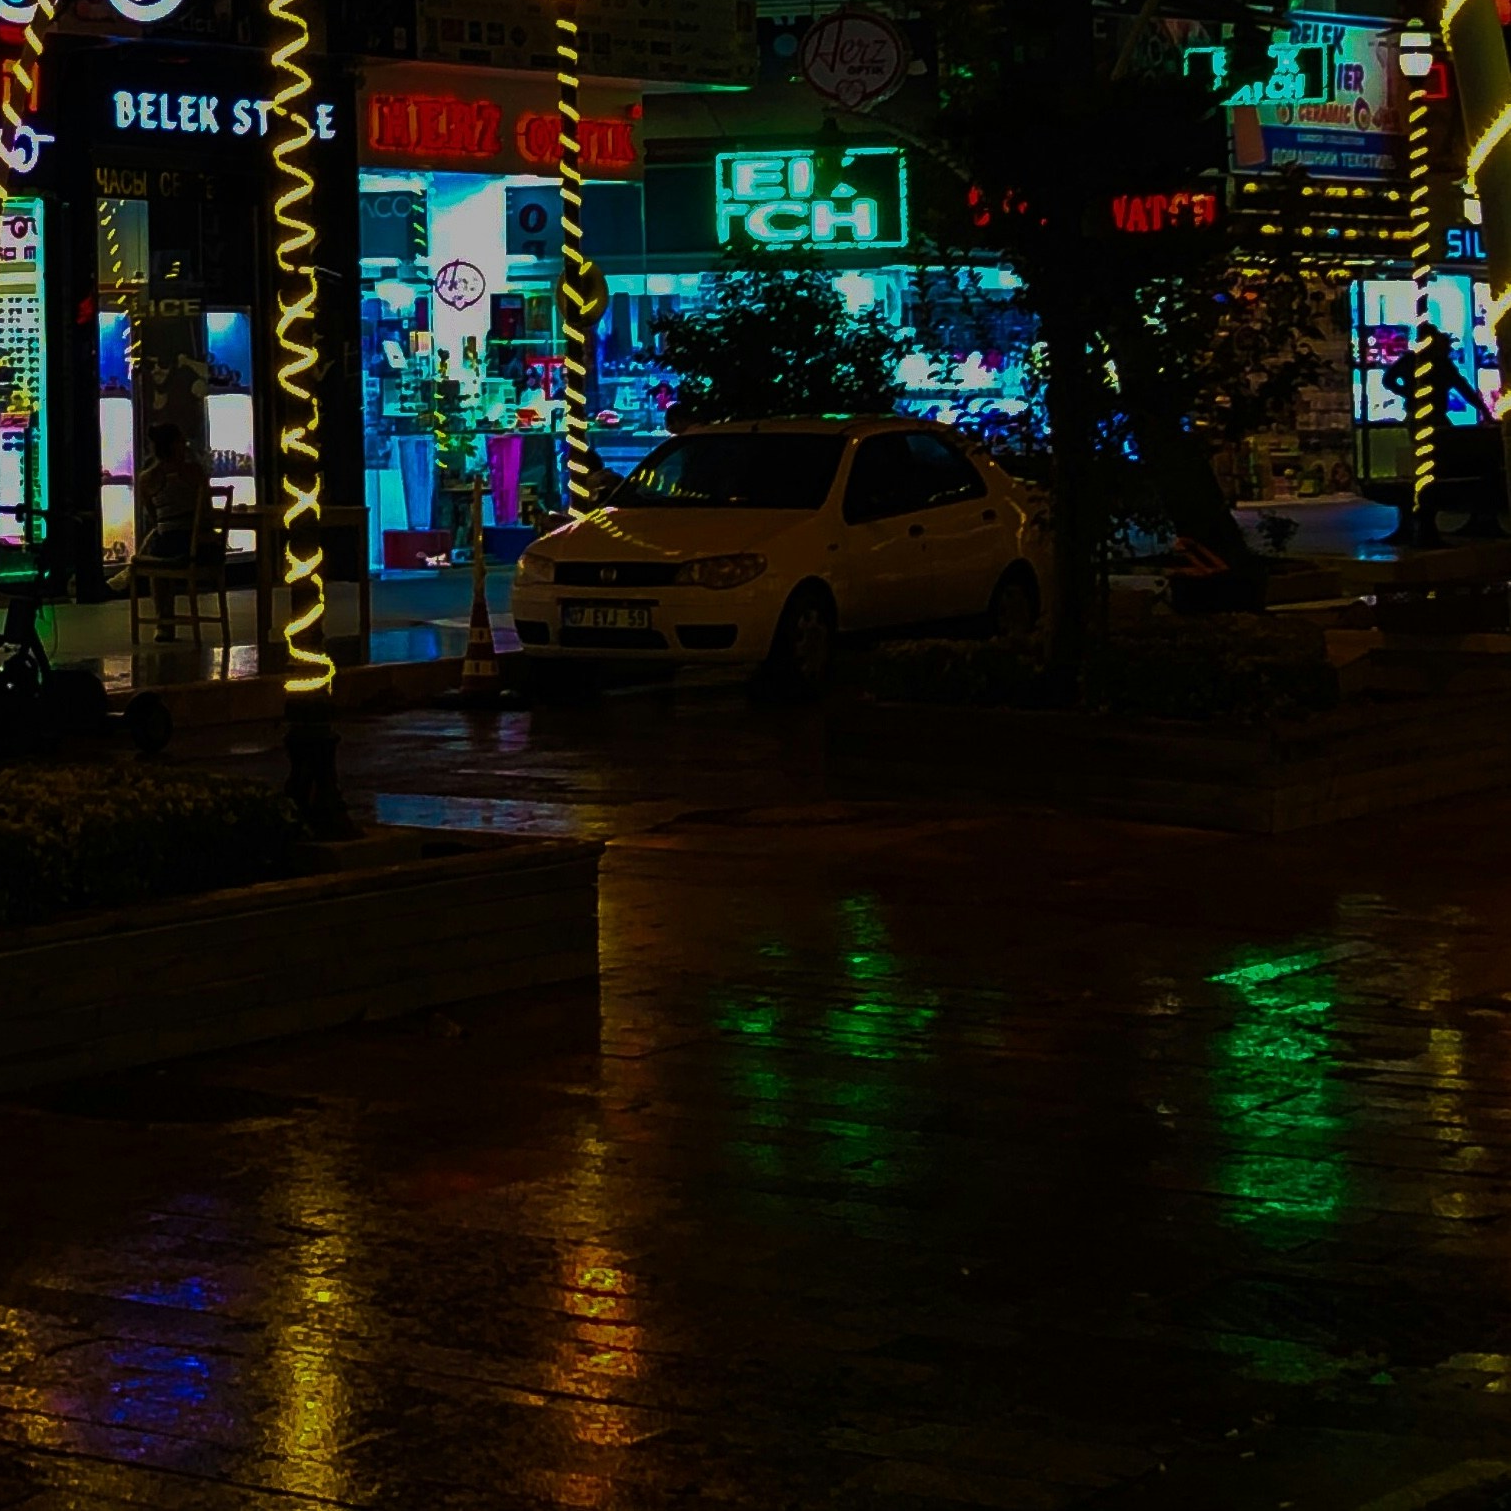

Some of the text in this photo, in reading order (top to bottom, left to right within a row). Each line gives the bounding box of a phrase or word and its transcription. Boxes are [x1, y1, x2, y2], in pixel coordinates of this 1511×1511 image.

[807, 9, 887, 72] Herz
[113, 89, 338, 140] BELEK STE
[96, 166, 148, 197] ЧАСЫ
